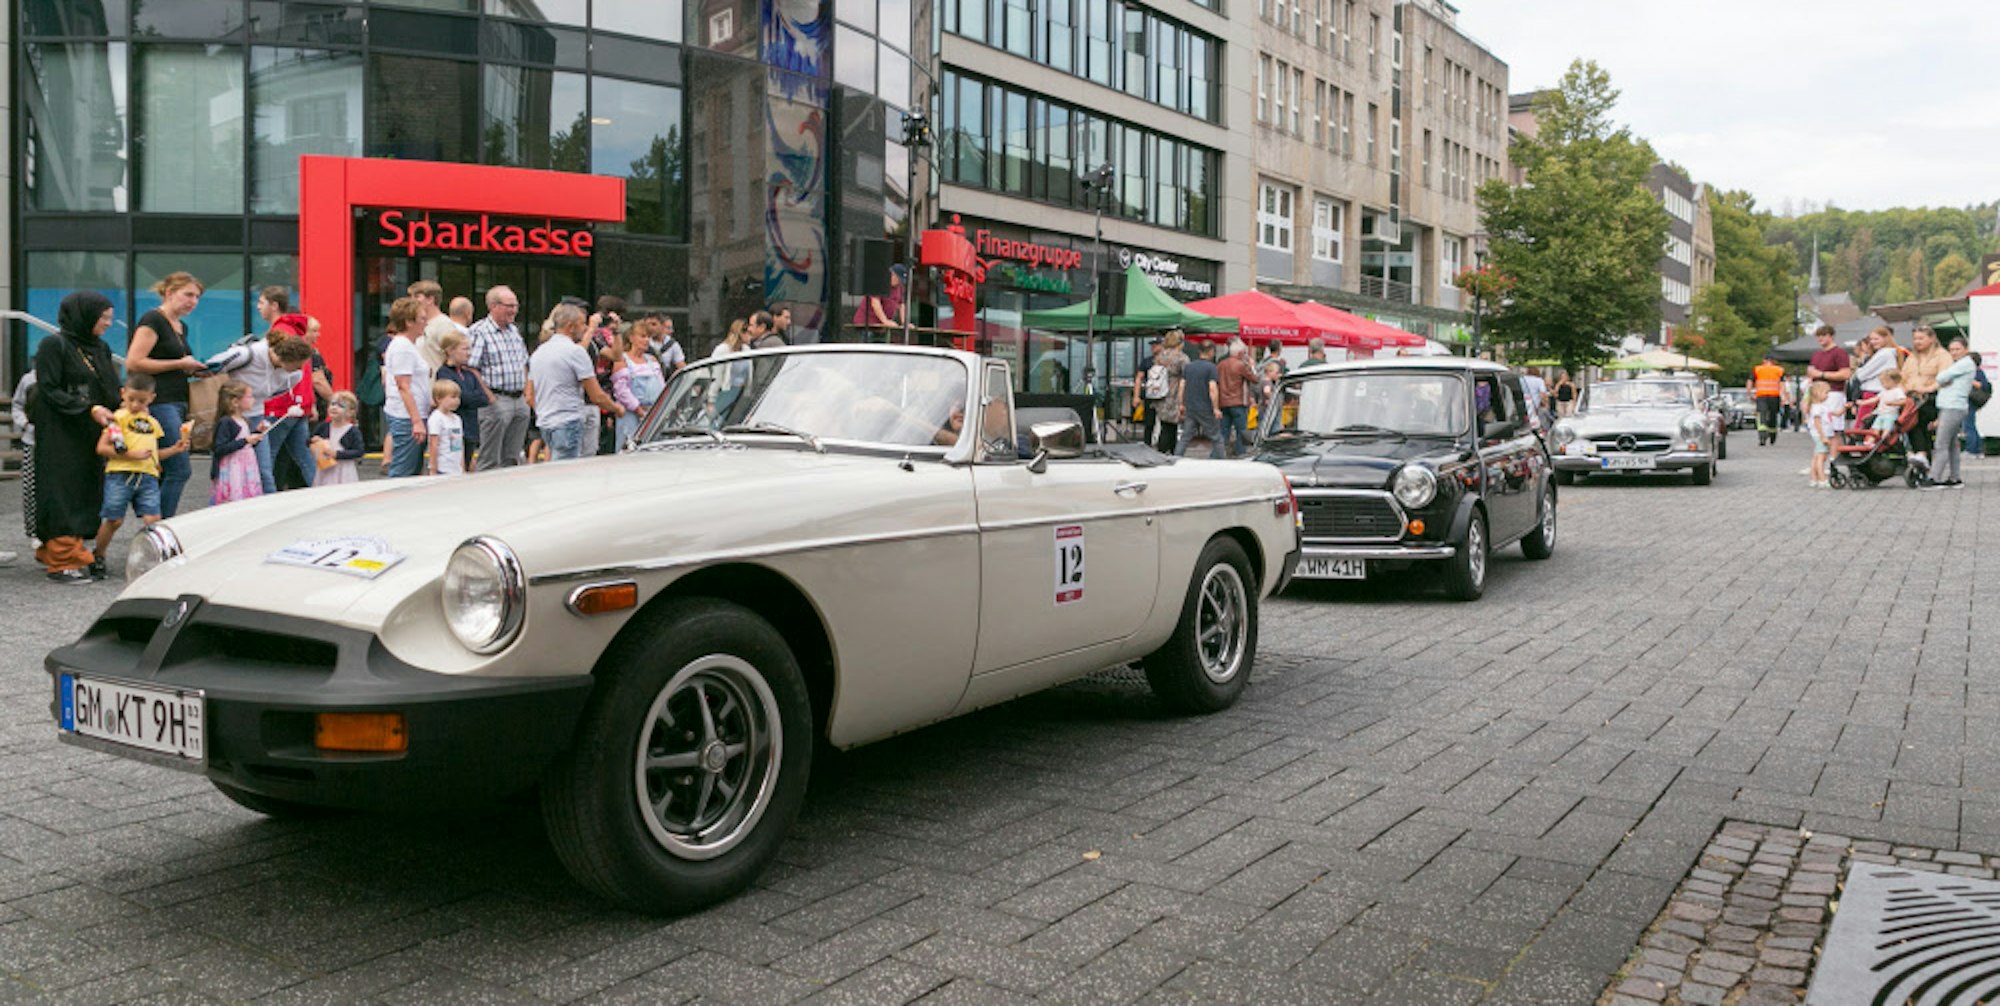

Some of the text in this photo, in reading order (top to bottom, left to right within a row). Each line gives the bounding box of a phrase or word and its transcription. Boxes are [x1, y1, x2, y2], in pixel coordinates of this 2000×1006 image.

[378, 210, 594, 257] Sparkasse
[976, 229, 1082, 271] Finanzgruppe
[1153, 256, 1180, 274] Center
[311, 548, 360, 567] 12
[1060, 544, 1083, 587] 12
[1307, 559, 1363, 576] WM 41H
[75, 684, 103, 730] GM
[116, 691, 146, 740] KT
[153, 699, 187, 748] 9H
